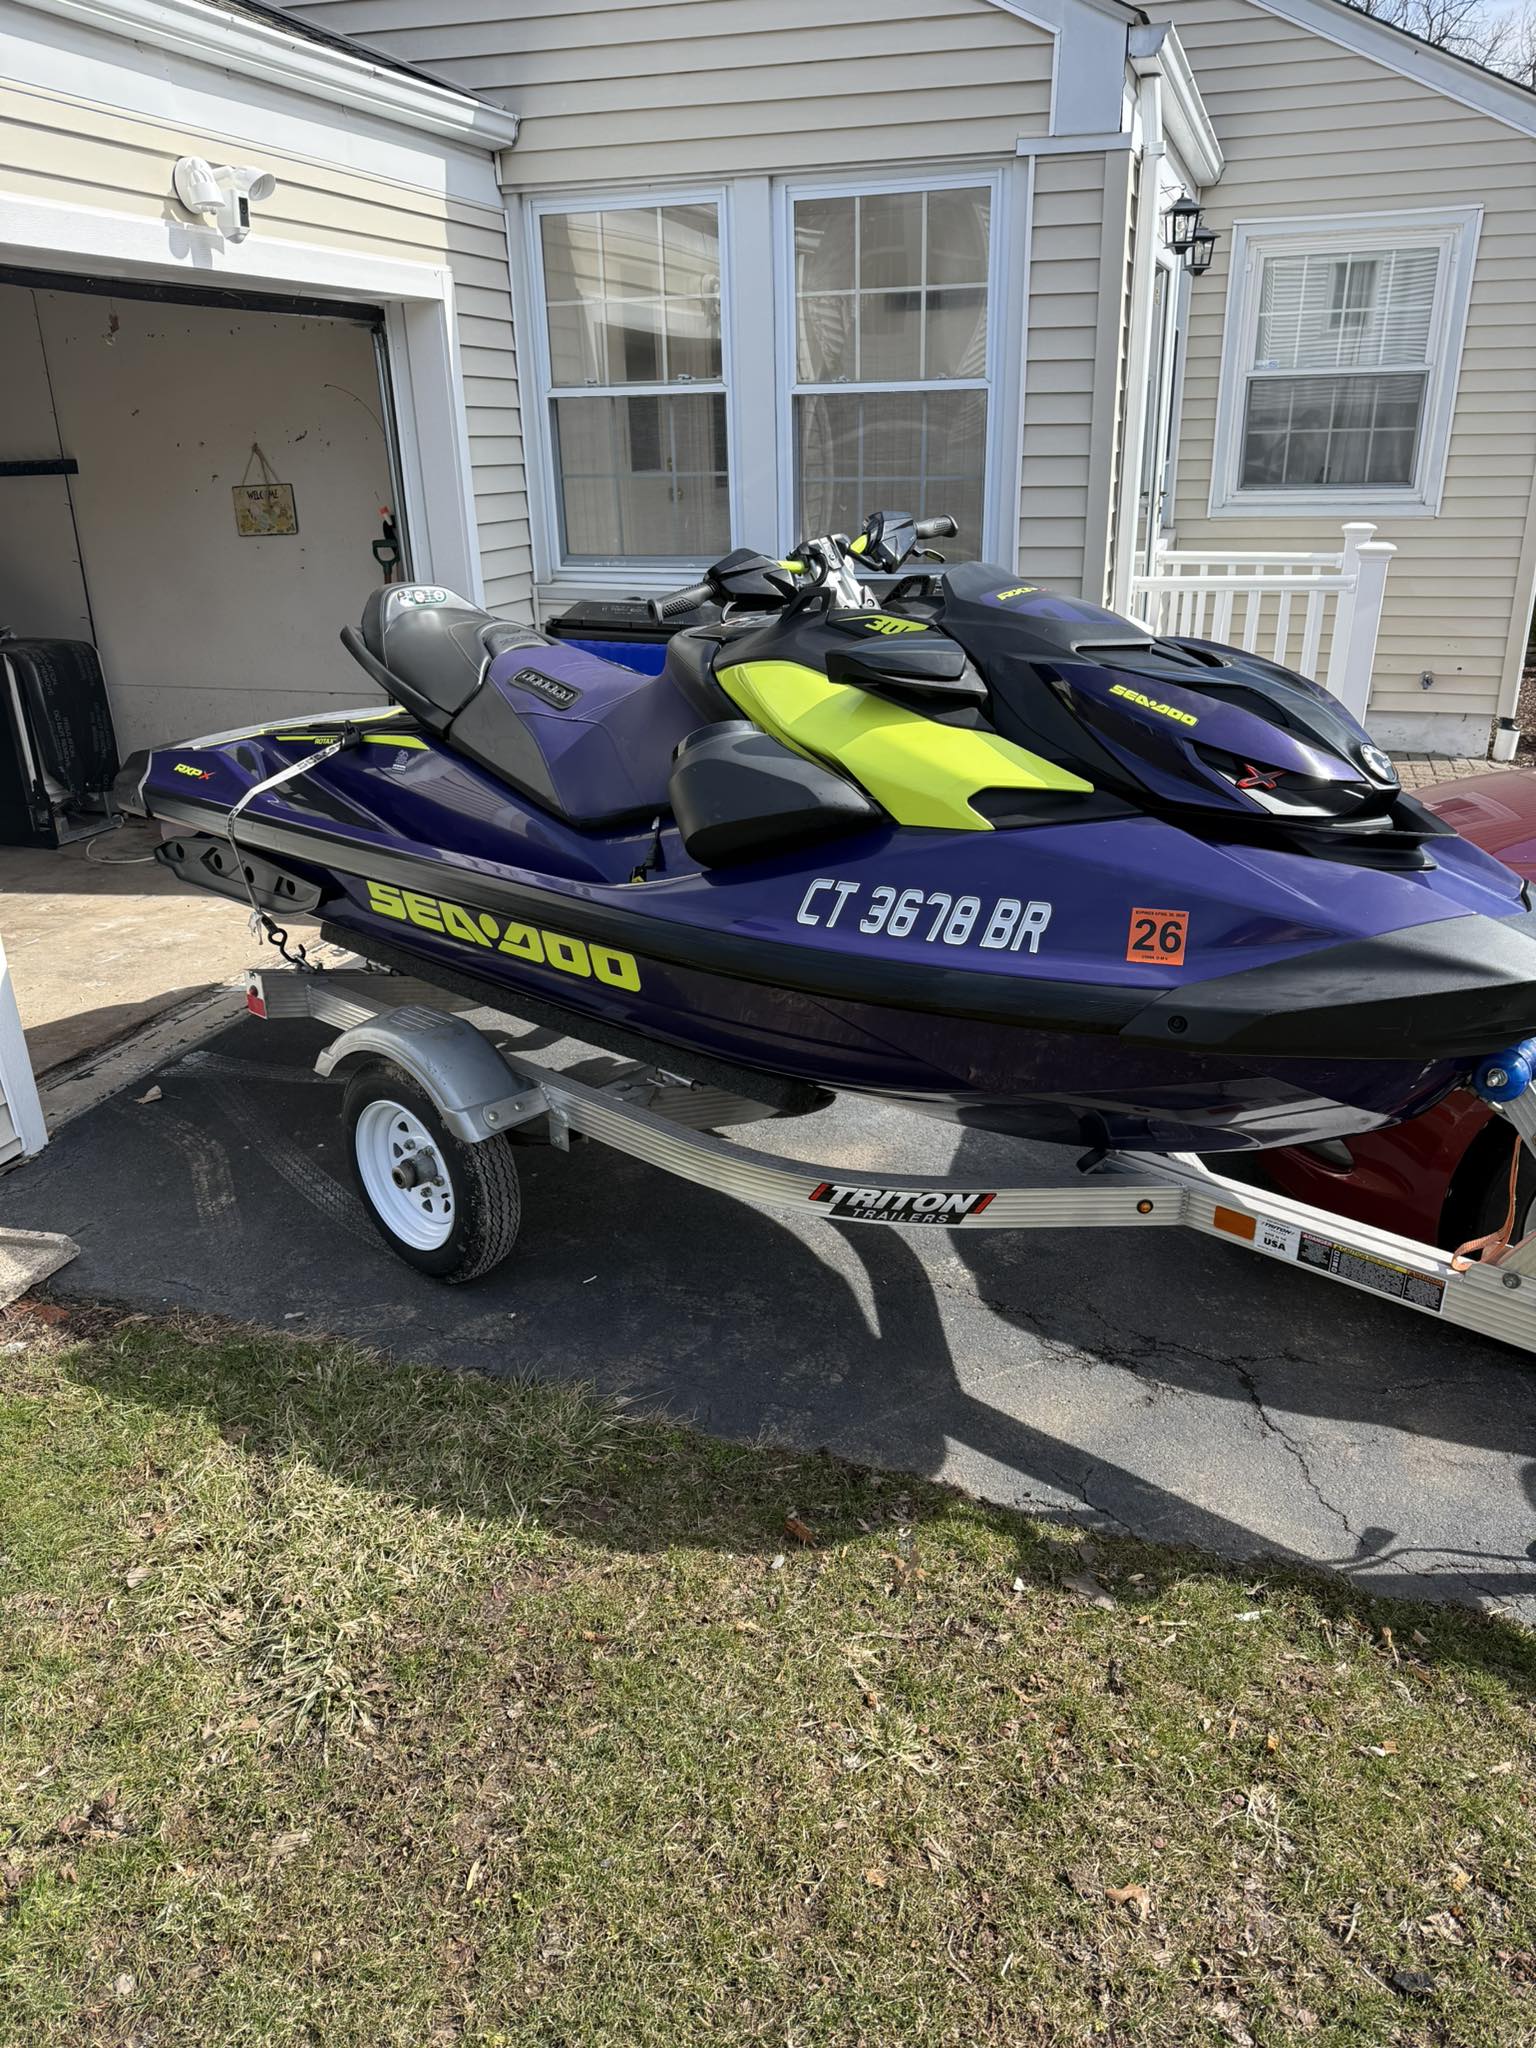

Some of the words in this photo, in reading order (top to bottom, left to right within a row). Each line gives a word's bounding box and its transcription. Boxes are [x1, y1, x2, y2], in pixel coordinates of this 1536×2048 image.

[796, 878, 861, 928] CT
[859, 885, 982, 946] 3678
[979, 897, 1052, 954] BR
[1132, 918, 1182, 953] 26
[828, 1185, 980, 1213] TRITON
[853, 1208, 949, 1223] TRAILERS
[1263, 1237, 1286, 1251] USA
